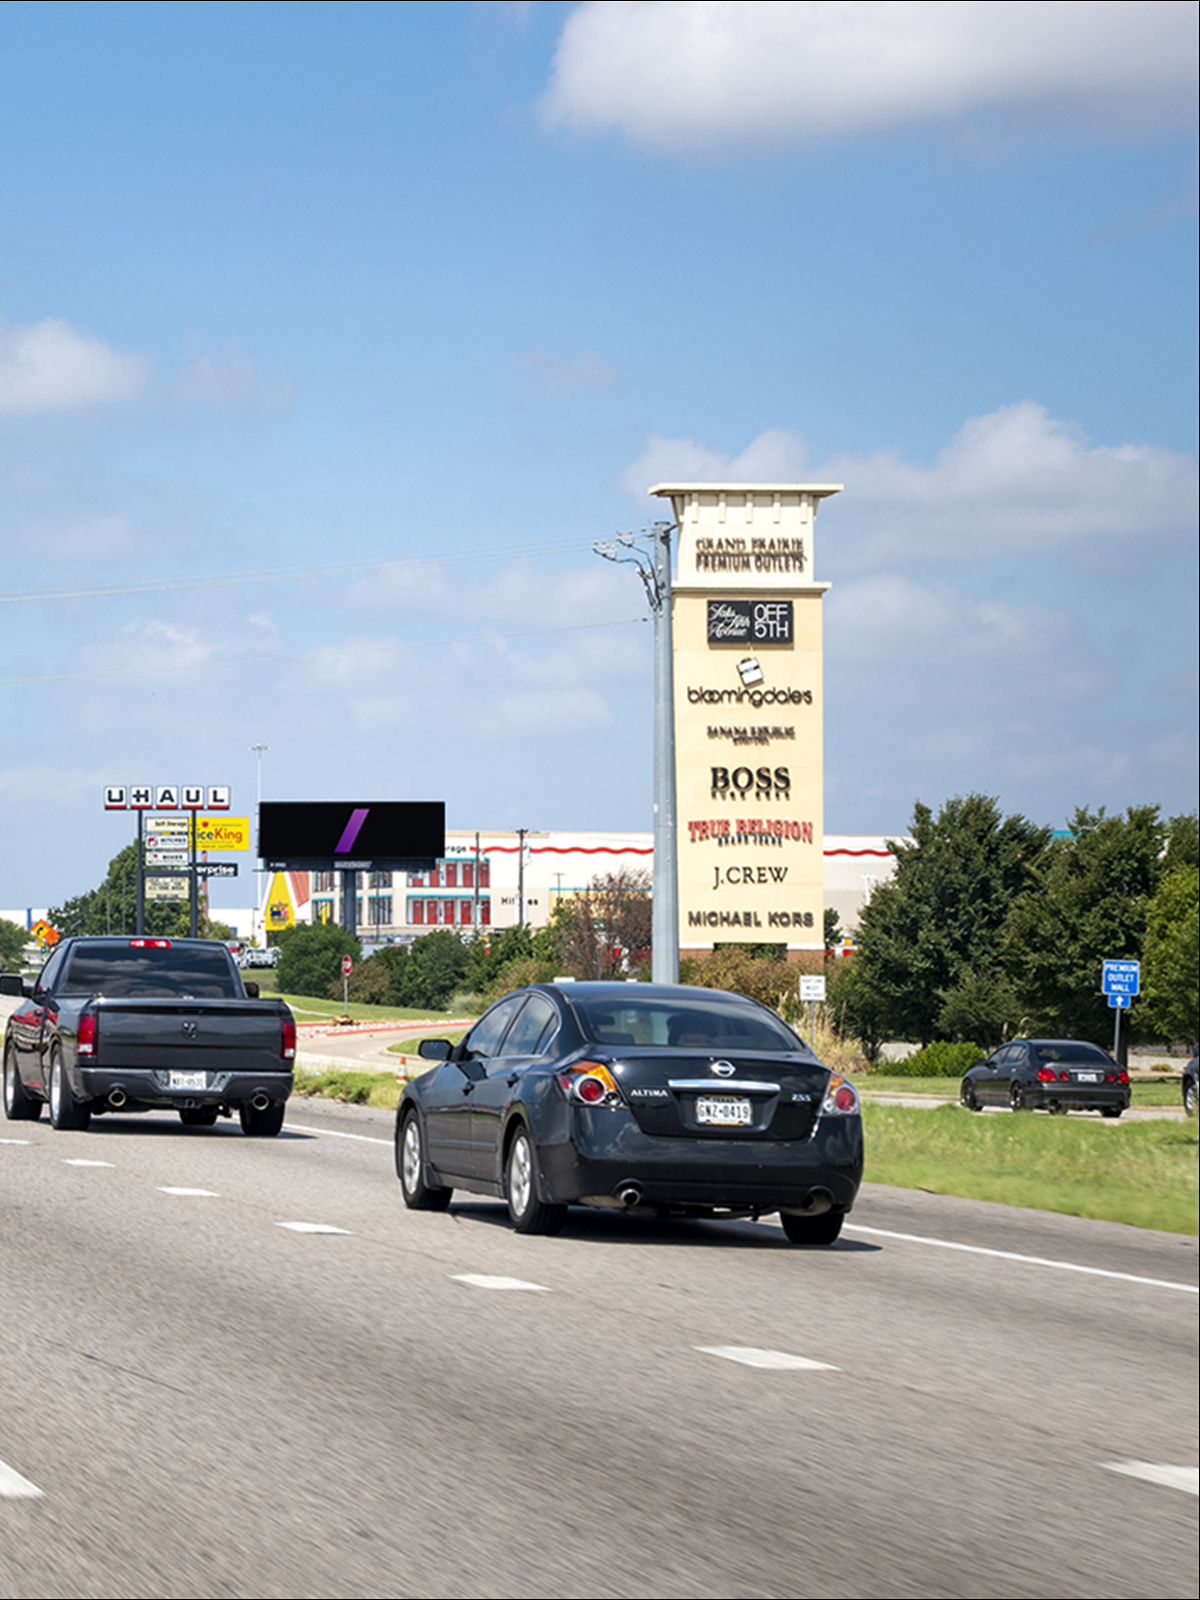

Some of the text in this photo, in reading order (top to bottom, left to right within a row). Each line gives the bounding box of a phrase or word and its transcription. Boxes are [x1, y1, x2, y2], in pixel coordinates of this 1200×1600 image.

[696, 538, 804, 550] GRAND PRAIRIE
[696, 552, 750, 571] PREMIUM
[754, 603, 788, 621] OFF
[754, 621, 789, 638] 5TH
[711, 766, 791, 791] BOSS
[688, 819, 813, 844] TRUE RELIGION
[712, 866, 789, 891] J.CREW
[687, 911, 814, 928] MICHAEL KORS
[1104, 963, 1138, 972] PREMIUM
[1107, 973, 1135, 983] OUTLET
[1110, 984, 1130, 993] MALL
[630, 1089, 668, 1098] ALTIMA
